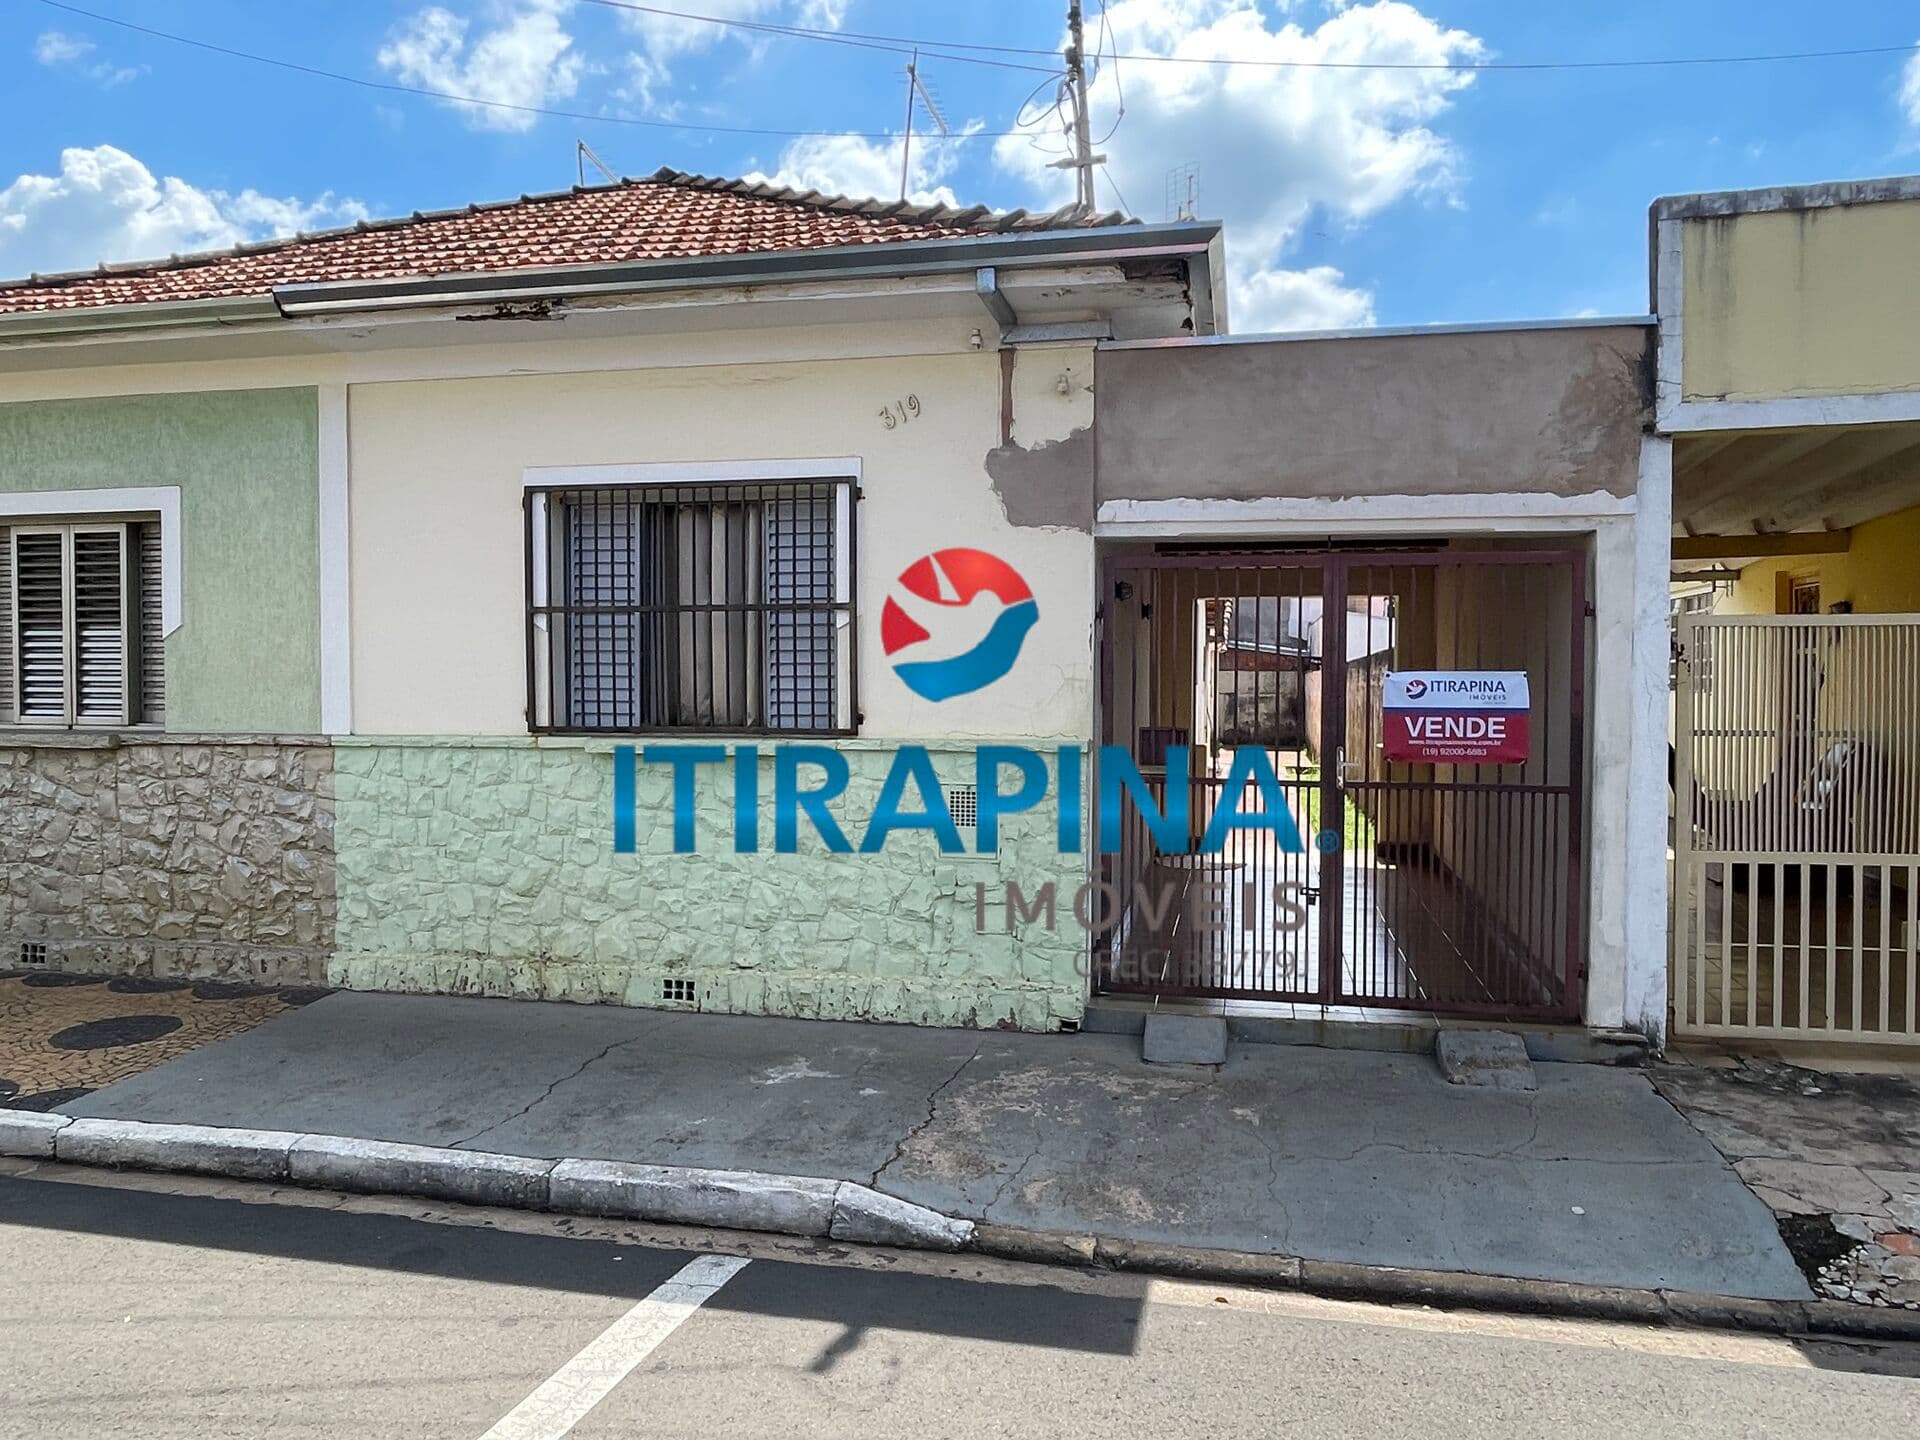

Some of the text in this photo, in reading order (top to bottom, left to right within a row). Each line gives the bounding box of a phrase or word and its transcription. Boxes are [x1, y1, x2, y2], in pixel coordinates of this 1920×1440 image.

[879, 393, 921, 430] 319
[1430, 680, 1506, 693] ITIRAPINA
[1404, 717, 1507, 738] VENDE
